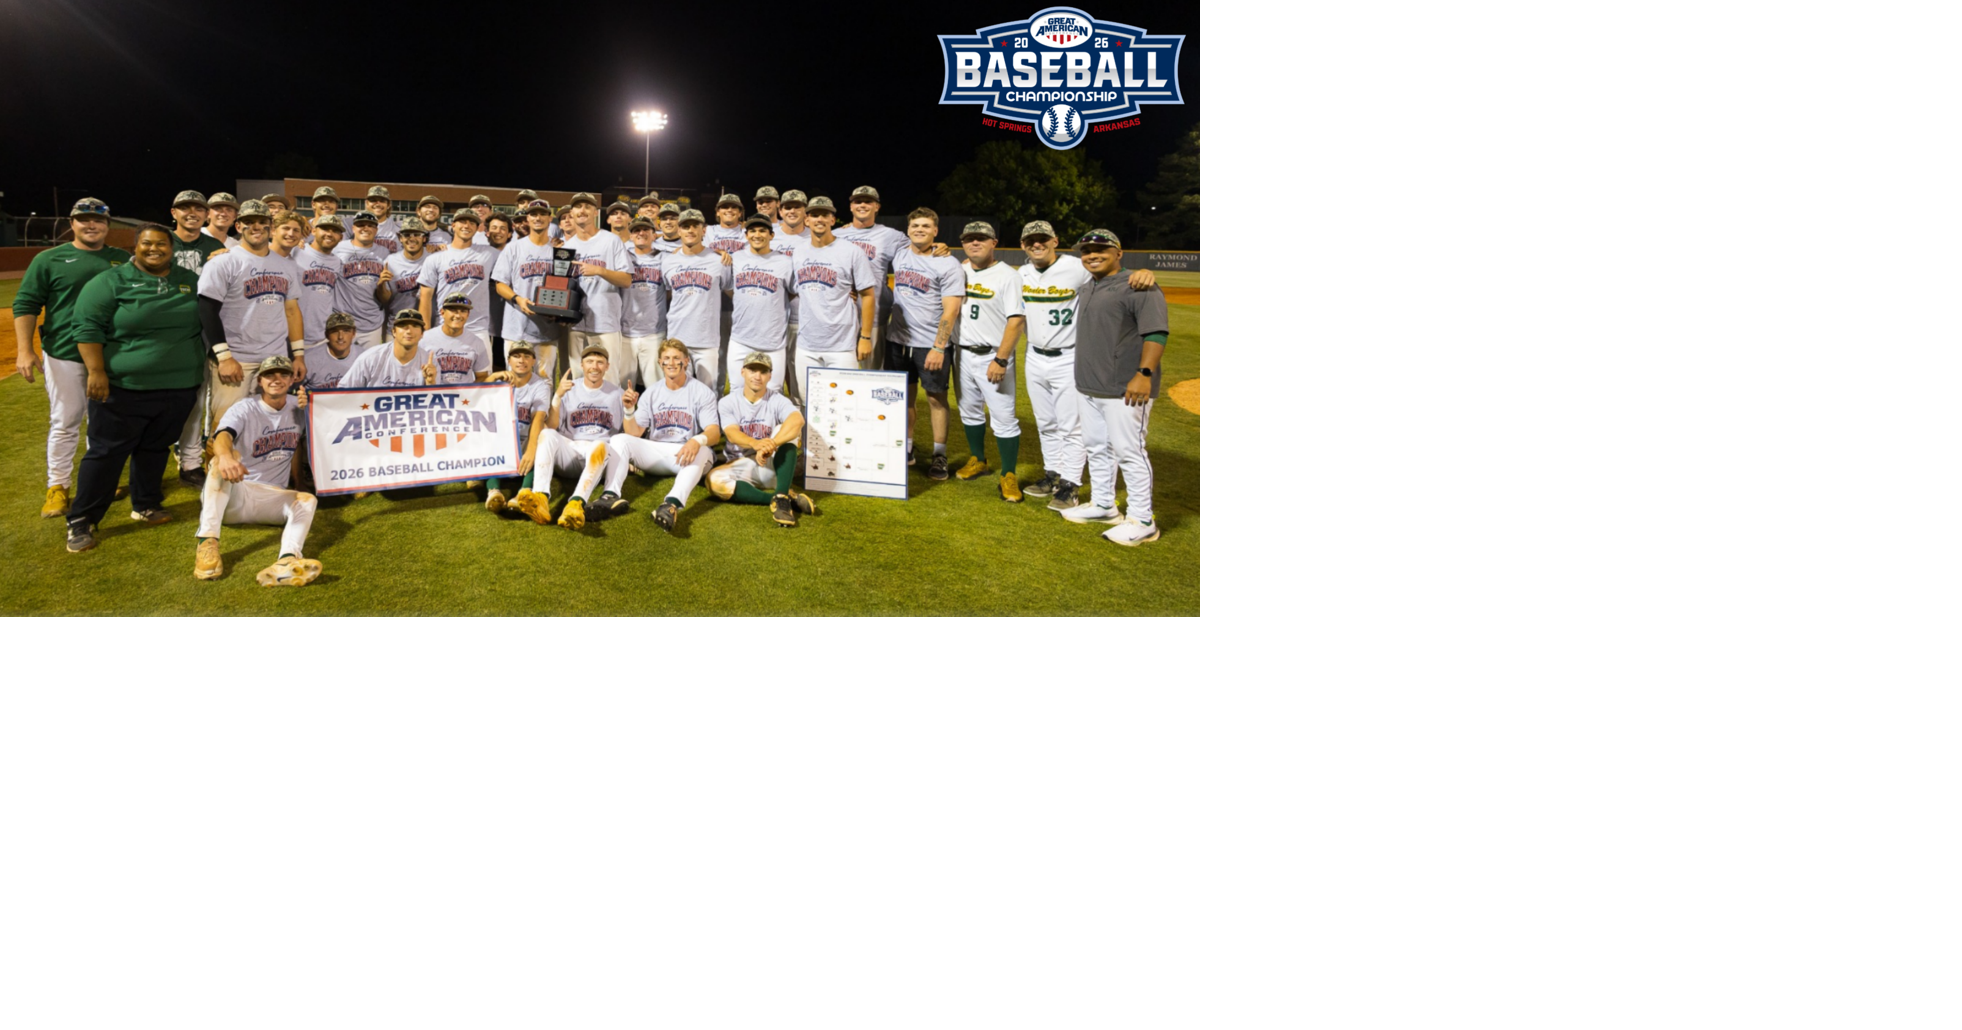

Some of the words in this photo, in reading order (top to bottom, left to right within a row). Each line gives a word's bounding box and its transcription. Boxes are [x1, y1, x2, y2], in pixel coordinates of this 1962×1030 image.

[802, 258, 832, 267] Conference
[1150, 253, 1198, 261] RAYMOND
[250, 267, 284, 277] Conference
[444, 263, 485, 284] CHAMPIONS
[742, 264, 774, 273] Conference
[671, 271, 713, 290] CHAMPIONS
[735, 271, 779, 293] CHAMPIONS
[797, 265, 838, 288] CHAMPIONS
[973, 283, 990, 293] Boys
[1047, 285, 1070, 296] Boys
[970, 304, 980, 320] 9
[1048, 308, 1073, 326] 32
[435, 348, 468, 357] Conference
[373, 393, 460, 413] GREAT
[658, 402, 687, 411] Conference
[262, 426, 297, 436] Conference
[331, 409, 498, 445] AMERICAN
[364, 425, 471, 439] CONFERENCE
[330, 467, 364, 481] 2026
[368, 461, 434, 477] BASEBALL
[437, 454, 506, 471] CHAMPION
